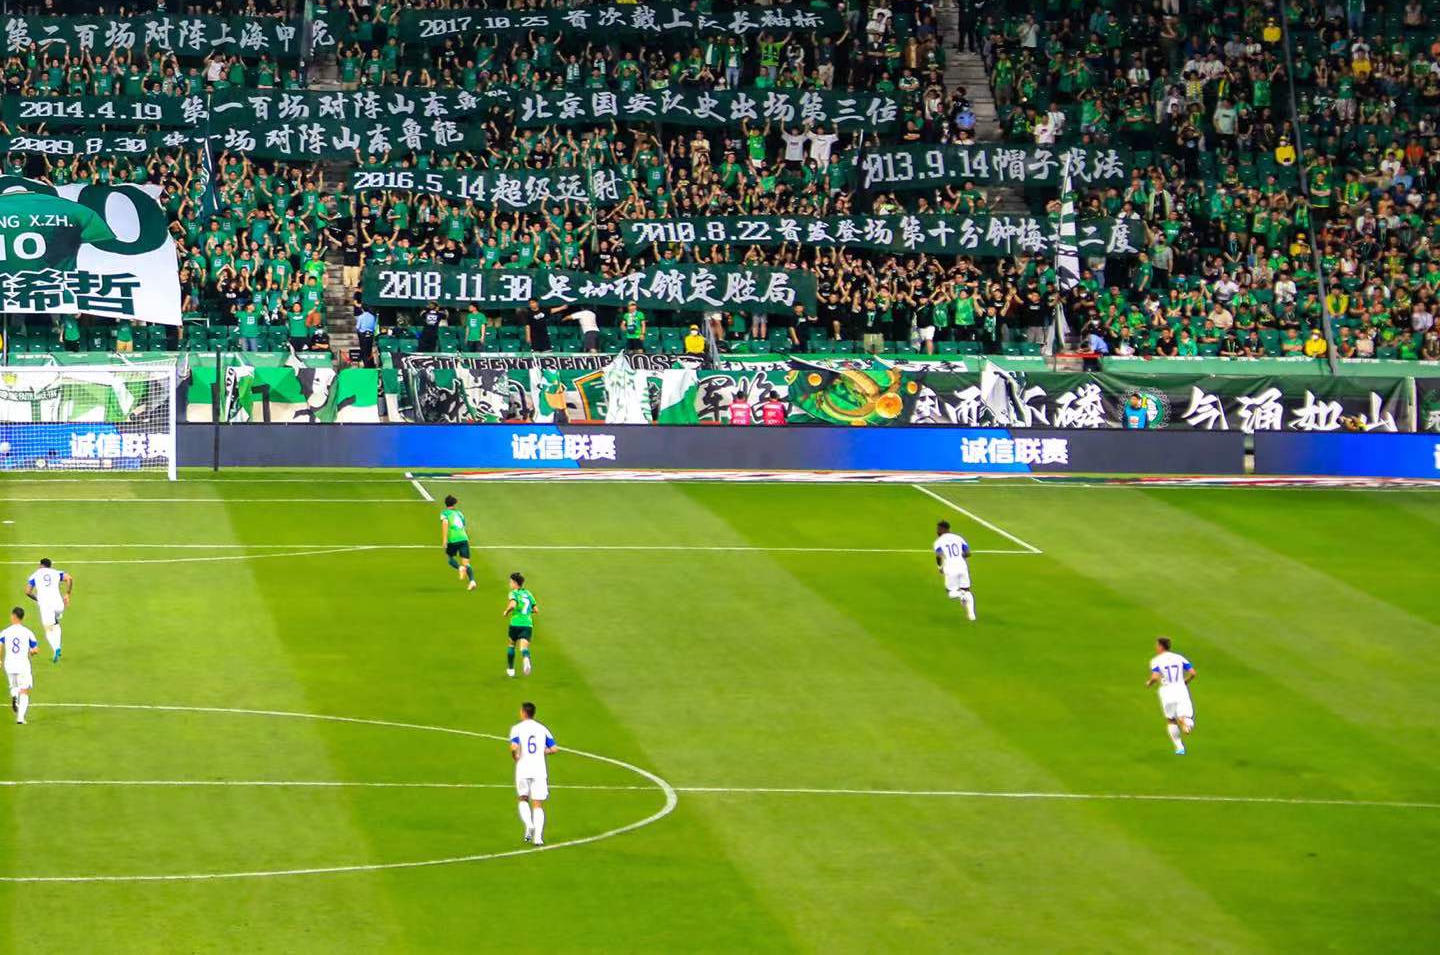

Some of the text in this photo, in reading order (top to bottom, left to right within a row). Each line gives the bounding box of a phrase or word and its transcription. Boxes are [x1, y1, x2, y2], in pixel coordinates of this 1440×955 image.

[19, 101, 162, 120] 2014.4.19
[378, 271, 532, 302] 2018.11.30
[511, 433, 616, 461] 诚信联赛
[960, 437, 1068, 465] 诚信联赛
[945, 543, 960, 558] 10
[43, 574, 51, 587] 9
[11, 637, 20, 654] 8
[1164, 664, 1179, 683] 17
[527, 735, 537, 754] 6
